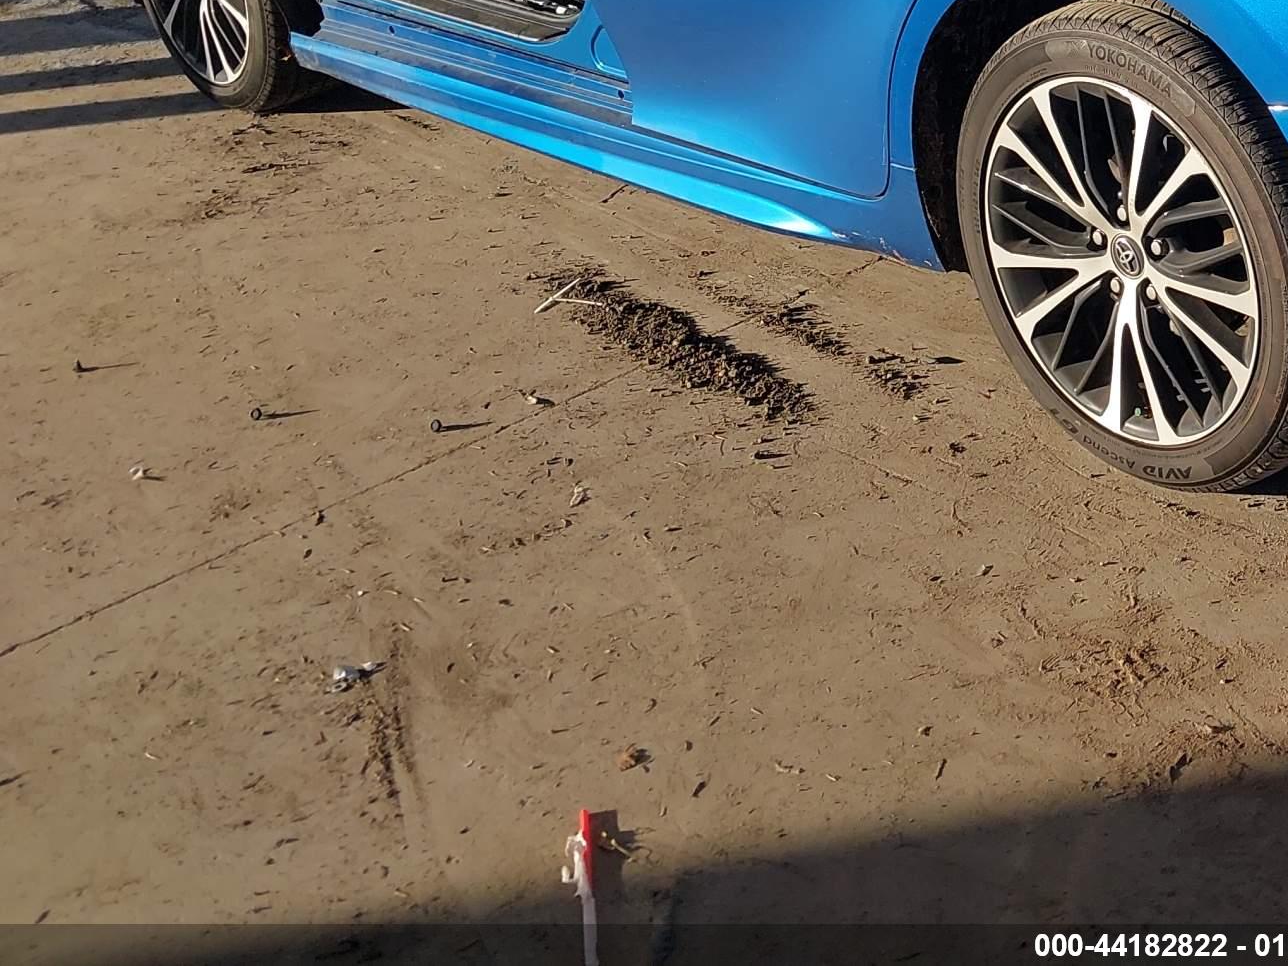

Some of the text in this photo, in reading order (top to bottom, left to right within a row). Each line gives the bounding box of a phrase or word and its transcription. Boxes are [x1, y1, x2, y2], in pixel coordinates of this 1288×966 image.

[1087, 43, 1172, 98] YOKOHAMA
[1083, 435, 1135, 468] Ascend
[1142, 466, 1193, 480] AVID
